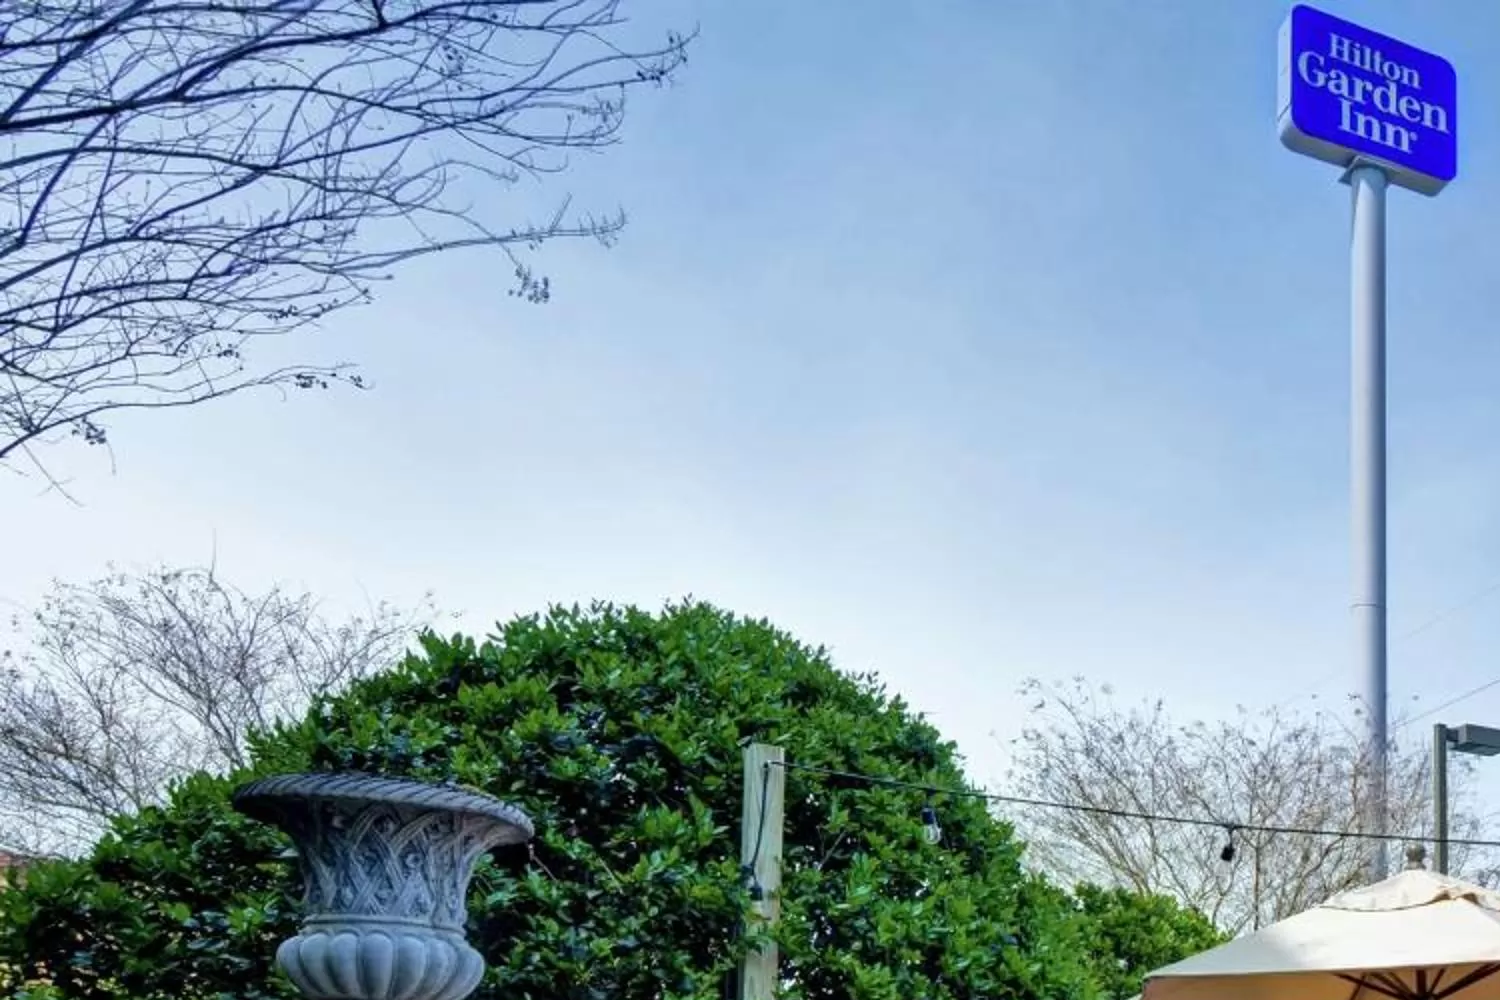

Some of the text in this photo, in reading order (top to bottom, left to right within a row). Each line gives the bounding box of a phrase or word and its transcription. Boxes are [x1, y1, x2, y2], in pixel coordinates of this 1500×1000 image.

[1329, 32, 1421, 89] Hilton
[1298, 51, 1449, 133] Garden
[1338, 97, 1412, 153] Inn
